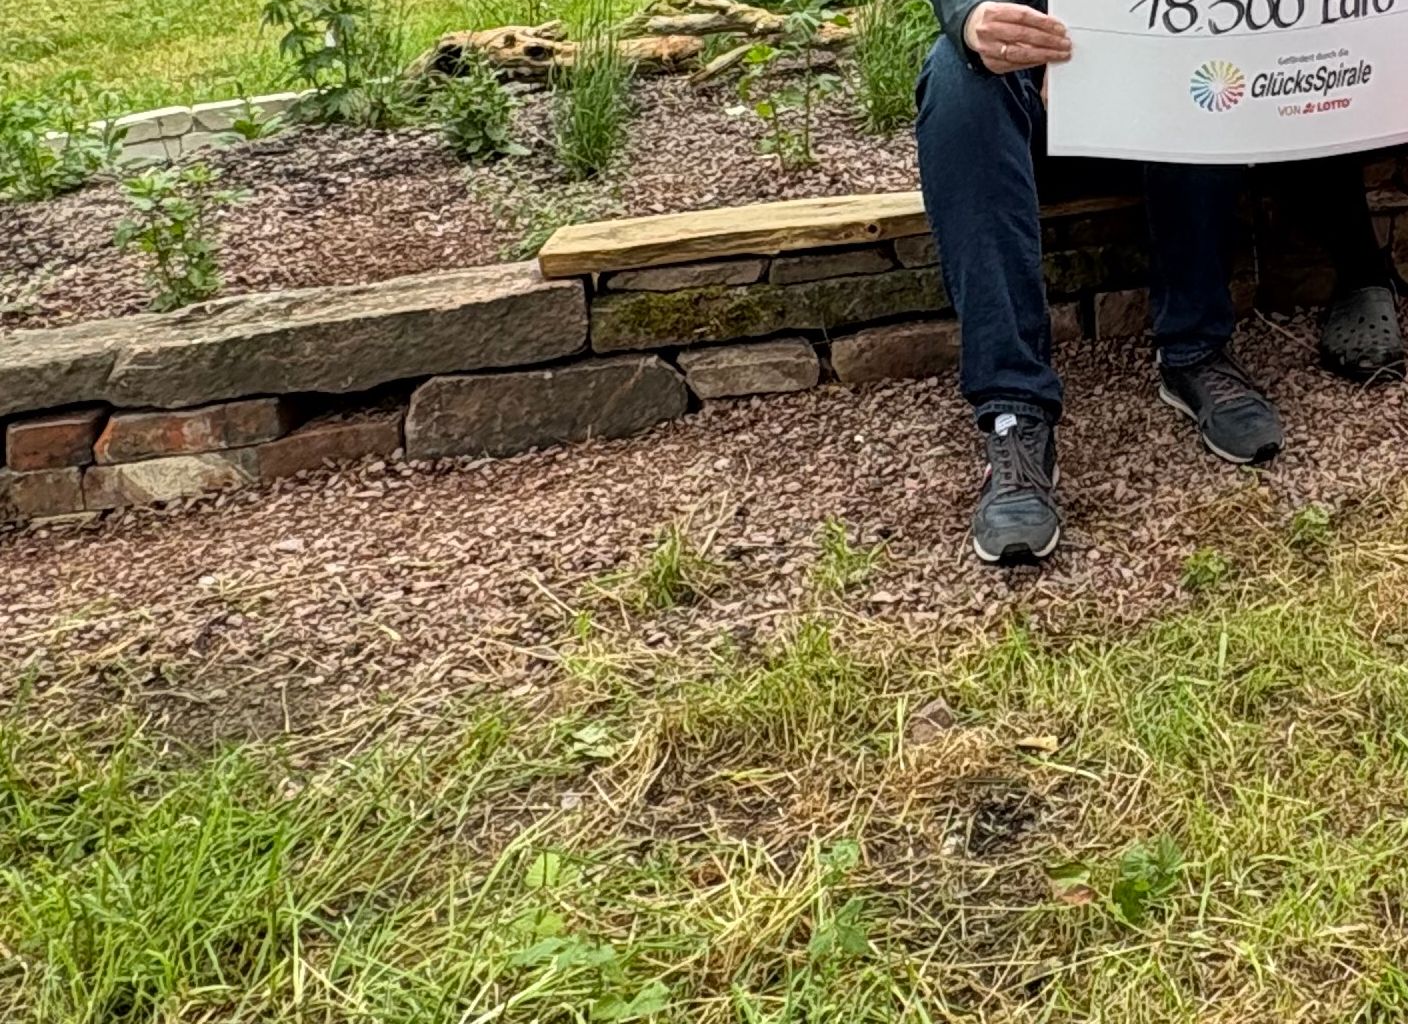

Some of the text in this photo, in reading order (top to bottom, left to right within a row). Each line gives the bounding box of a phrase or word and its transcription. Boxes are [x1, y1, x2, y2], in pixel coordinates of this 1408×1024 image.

[1315, 50, 1337, 61] durch
[1338, 47, 1349, 57] die
[1250, 59, 1372, 98] GlücksSpirale
[1277, 98, 1351, 117] VON LOTTO
